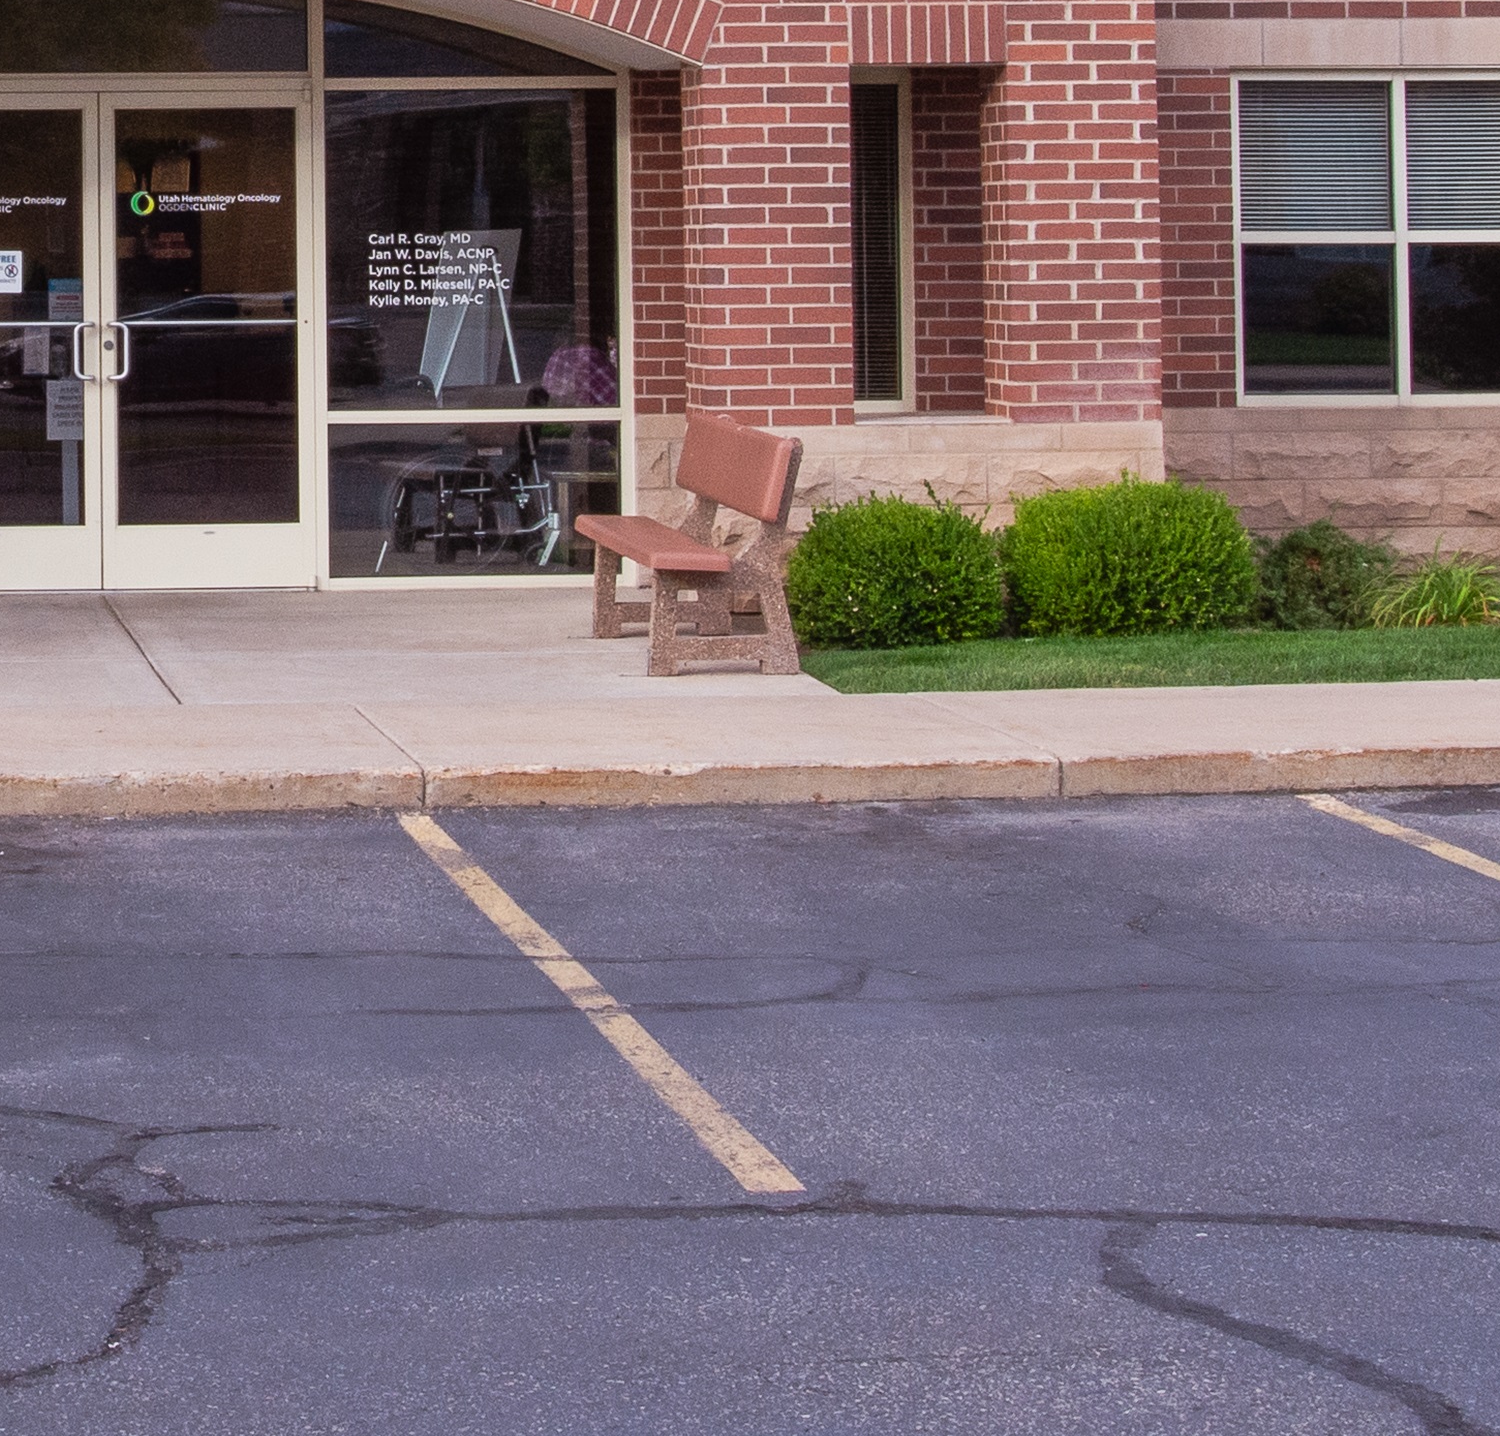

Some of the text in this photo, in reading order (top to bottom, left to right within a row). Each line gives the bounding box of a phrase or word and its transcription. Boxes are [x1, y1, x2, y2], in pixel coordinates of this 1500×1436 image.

[22, 196, 66, 206] Oncology
[158, 193, 281, 204] Utah Hematology Oncology
[158, 203, 227, 212] OGDENCLINIC
[368, 233, 471, 245] Carl R. Gray, MD
[368, 248, 494, 260] Jan W. Davis, ACNP
[368, 263, 502, 277] Lynn C. Larsen, NP-C
[369, 279, 510, 292] Kelly D. Mikesell, PA-C
[369, 294, 484, 307] Kylie Money, PA-C
